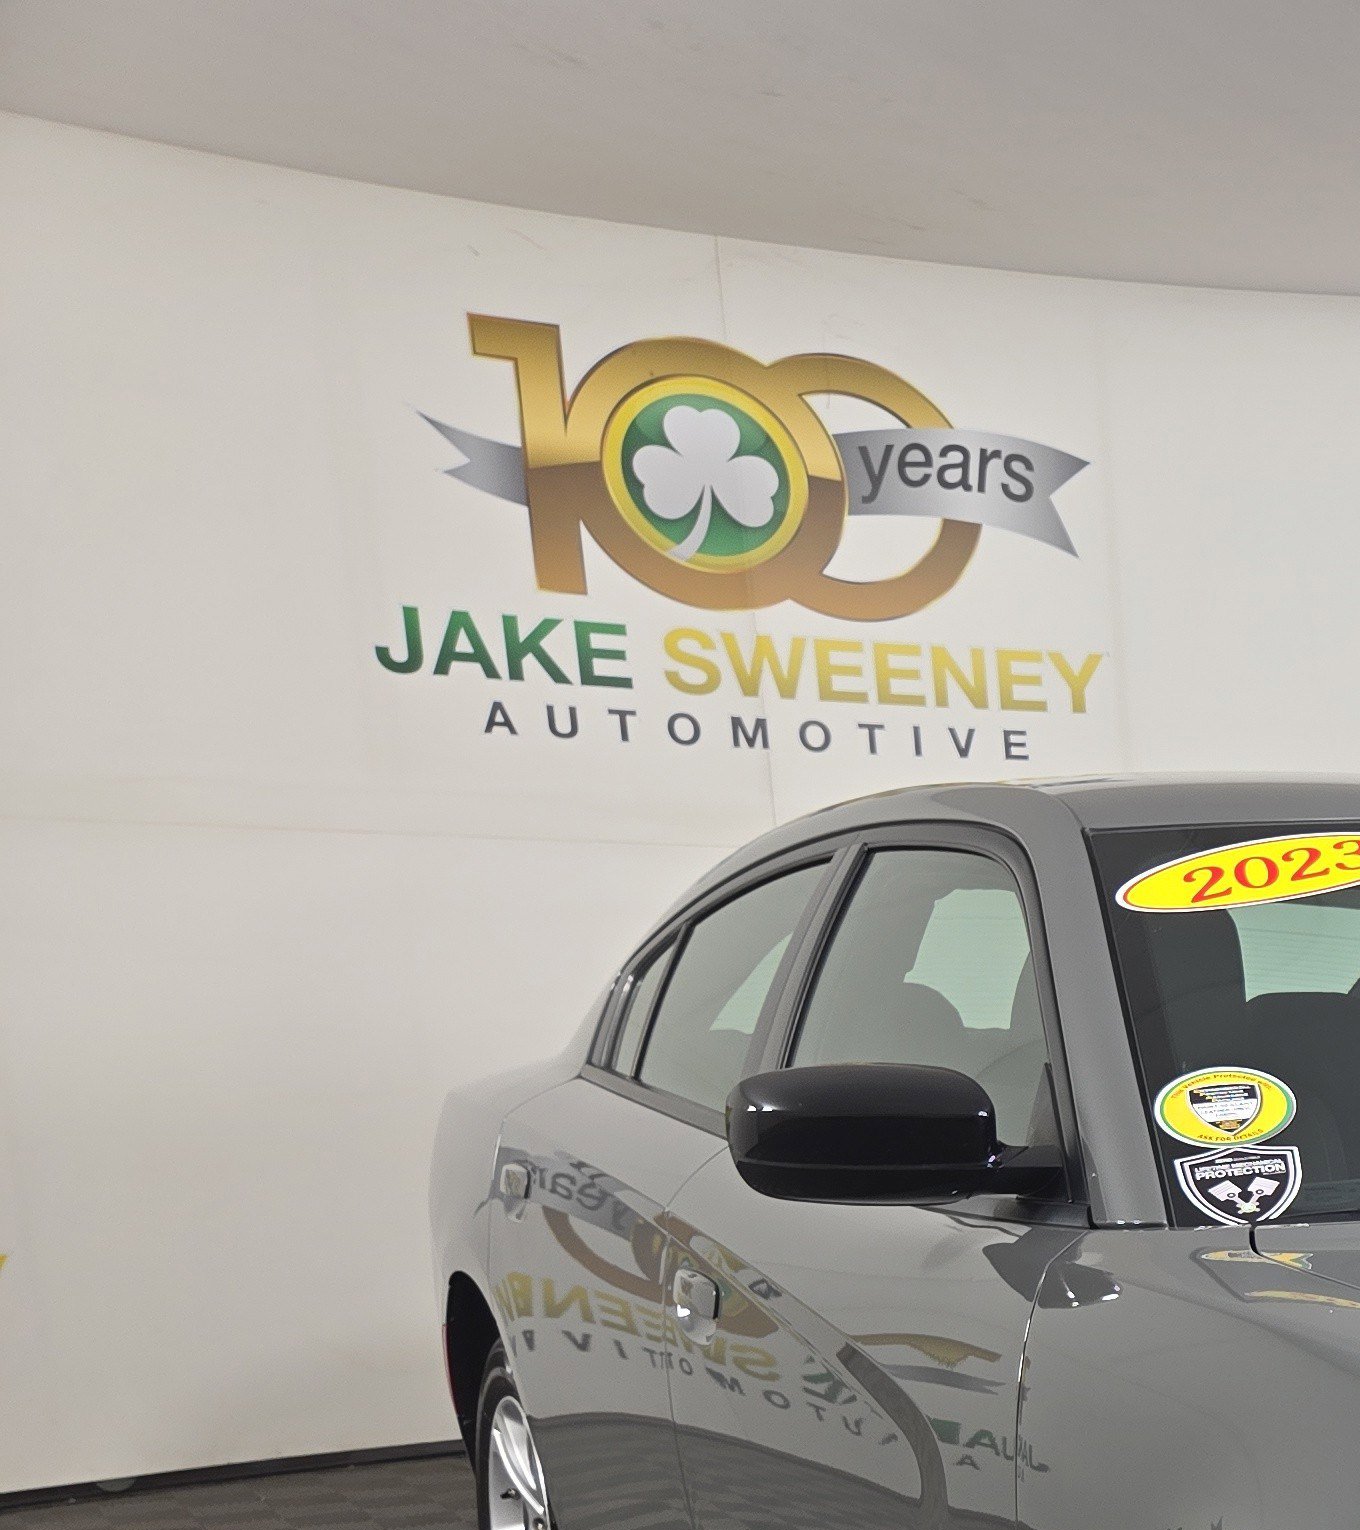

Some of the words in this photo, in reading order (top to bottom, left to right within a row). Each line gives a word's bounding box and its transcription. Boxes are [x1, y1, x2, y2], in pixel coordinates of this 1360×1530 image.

[856, 442, 1036, 504] years
[374, 605, 634, 690] JAKE
[661, 626, 1104, 714] SWEENEY
[484, 700, 1030, 761] AUTOMOTIVE
[1194, 1163, 1287, 1181] PROTECTION
